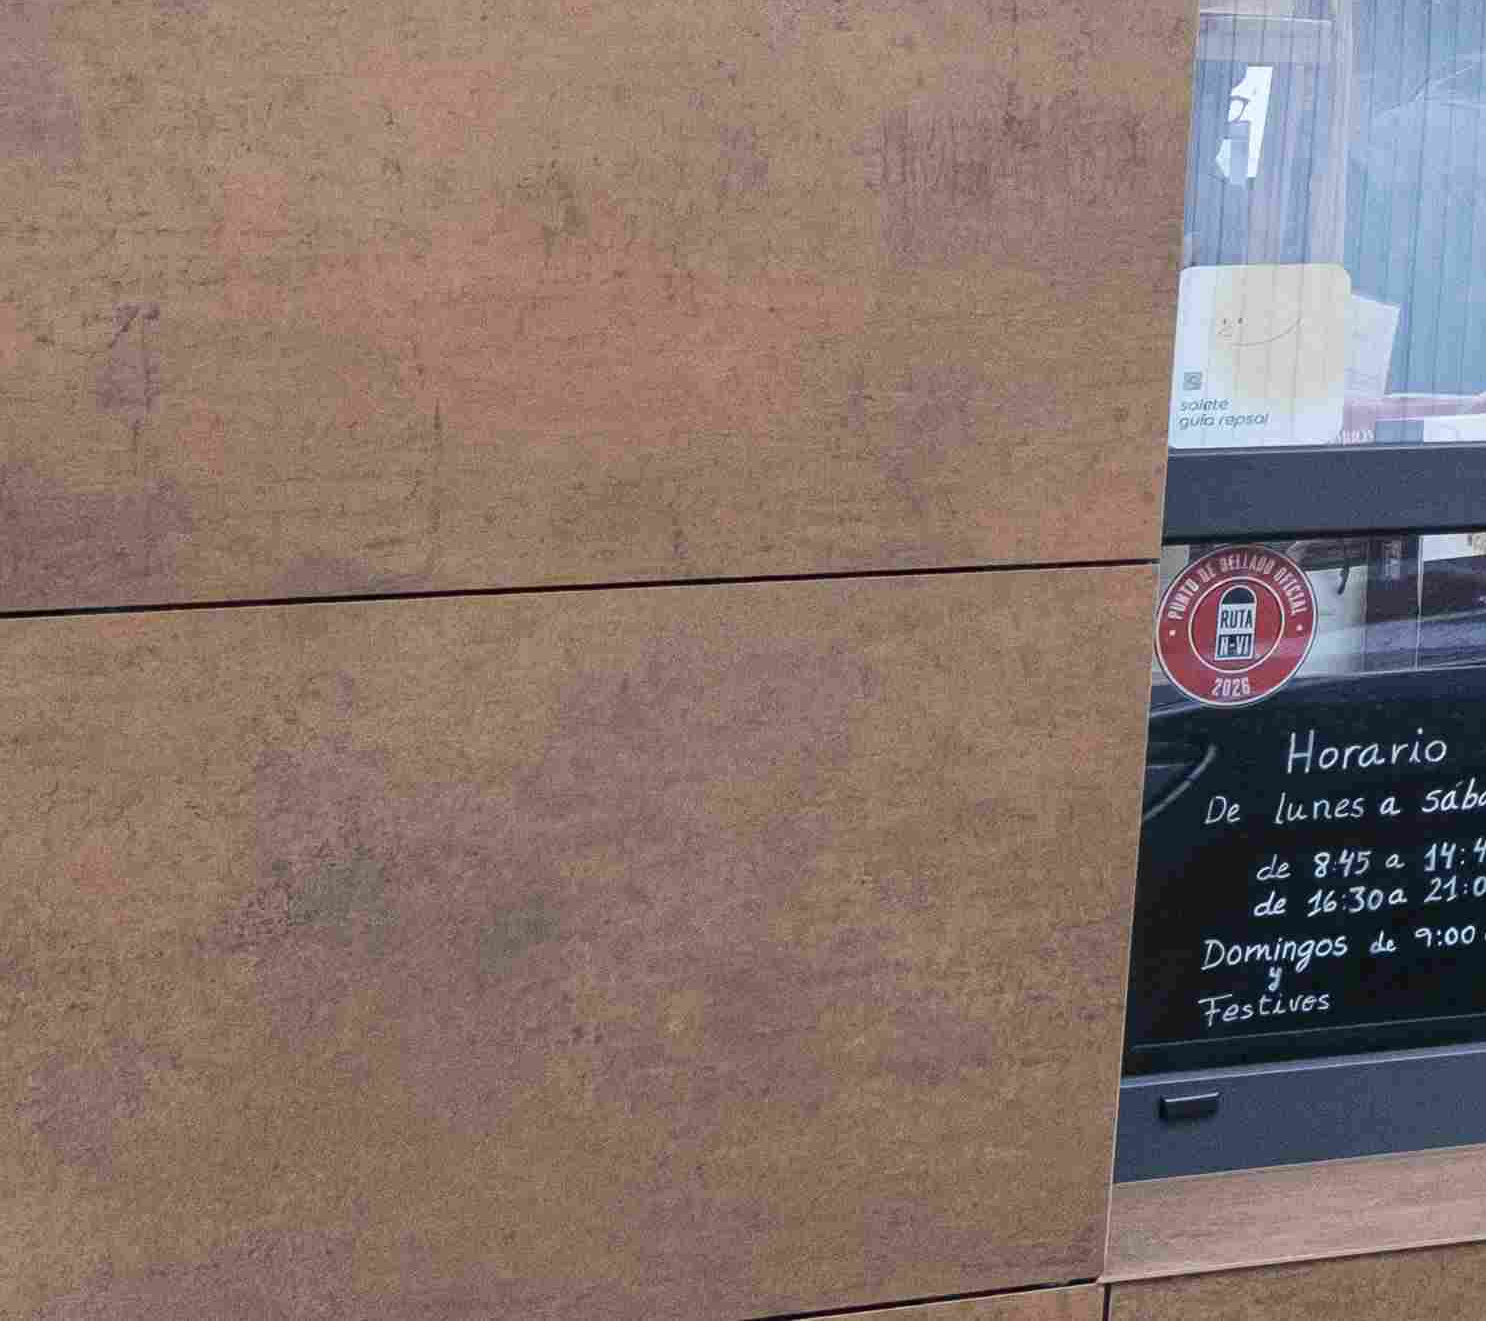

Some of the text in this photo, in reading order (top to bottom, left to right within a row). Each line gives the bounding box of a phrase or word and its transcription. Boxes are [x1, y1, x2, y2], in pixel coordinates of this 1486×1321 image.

[1167, 552, 1309, 620] PUNTO DE SELLADO OFICIAL
[1219, 609, 1254, 630] RUTA
[1219, 634, 1250, 657] N-VI
[1287, 727, 1447, 774] Horario
[1205, 795, 1241, 825] De
[1275, 792, 1365, 825] lunes
[1380, 795, 1401, 816] a
[1256, 855, 1291, 881] de
[1313, 849, 1371, 879] 8:45
[1385, 853, 1405, 869] a
[1254, 890, 1288, 917] de
[1307, 886, 1384, 917] 16:30
[1387, 888, 1408, 906] a
[1201, 935, 1349, 973] Domingos
[1370, 931, 1397, 955] de
[1415, 924, 1477, 948] 9:00
[1267, 966, 1283, 992] y
